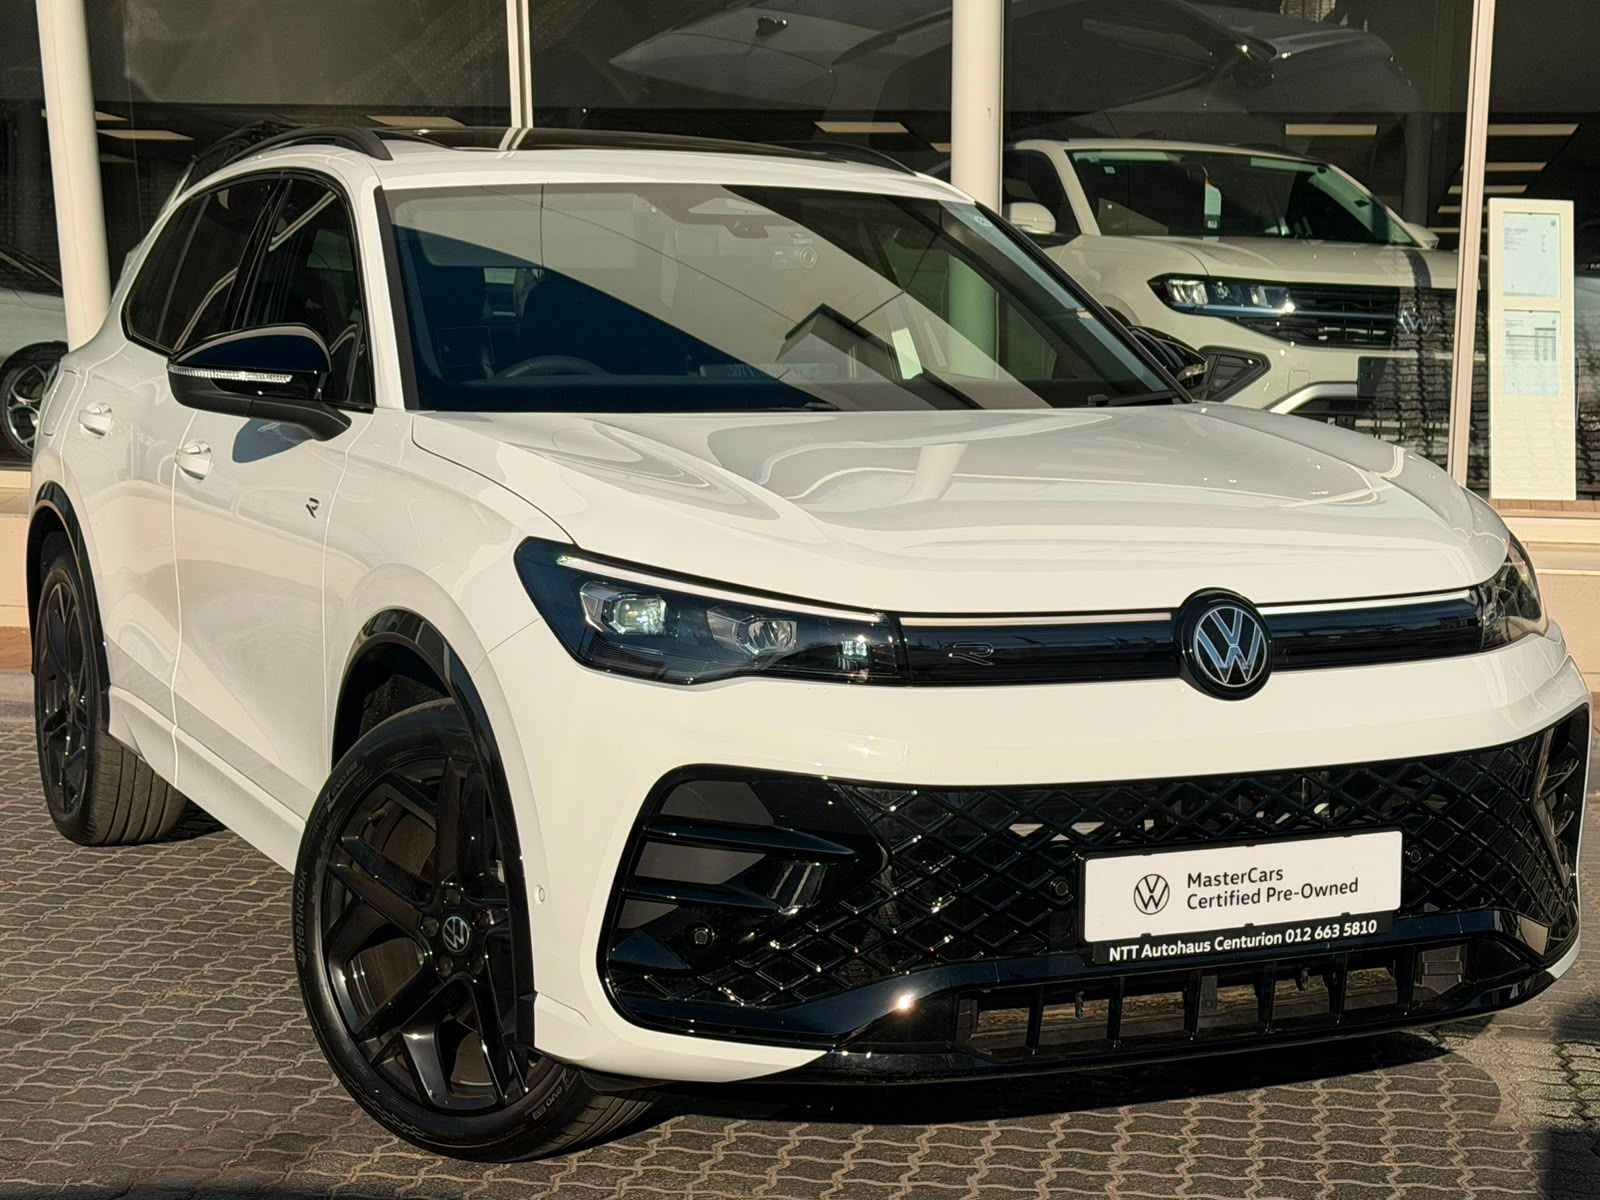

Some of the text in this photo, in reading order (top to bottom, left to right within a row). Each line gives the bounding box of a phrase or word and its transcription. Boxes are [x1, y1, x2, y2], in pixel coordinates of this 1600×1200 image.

[1193, 606, 1267, 688] VW
[1133, 873, 1170, 915] VW
[1186, 866, 1284, 889] MasterCars
[1186, 876, 1359, 910] Certified Pre-Owned
[443, 915, 470, 952] VW
[1109, 919, 1378, 962] NTT Autohaus Centurion 012 663 5810
